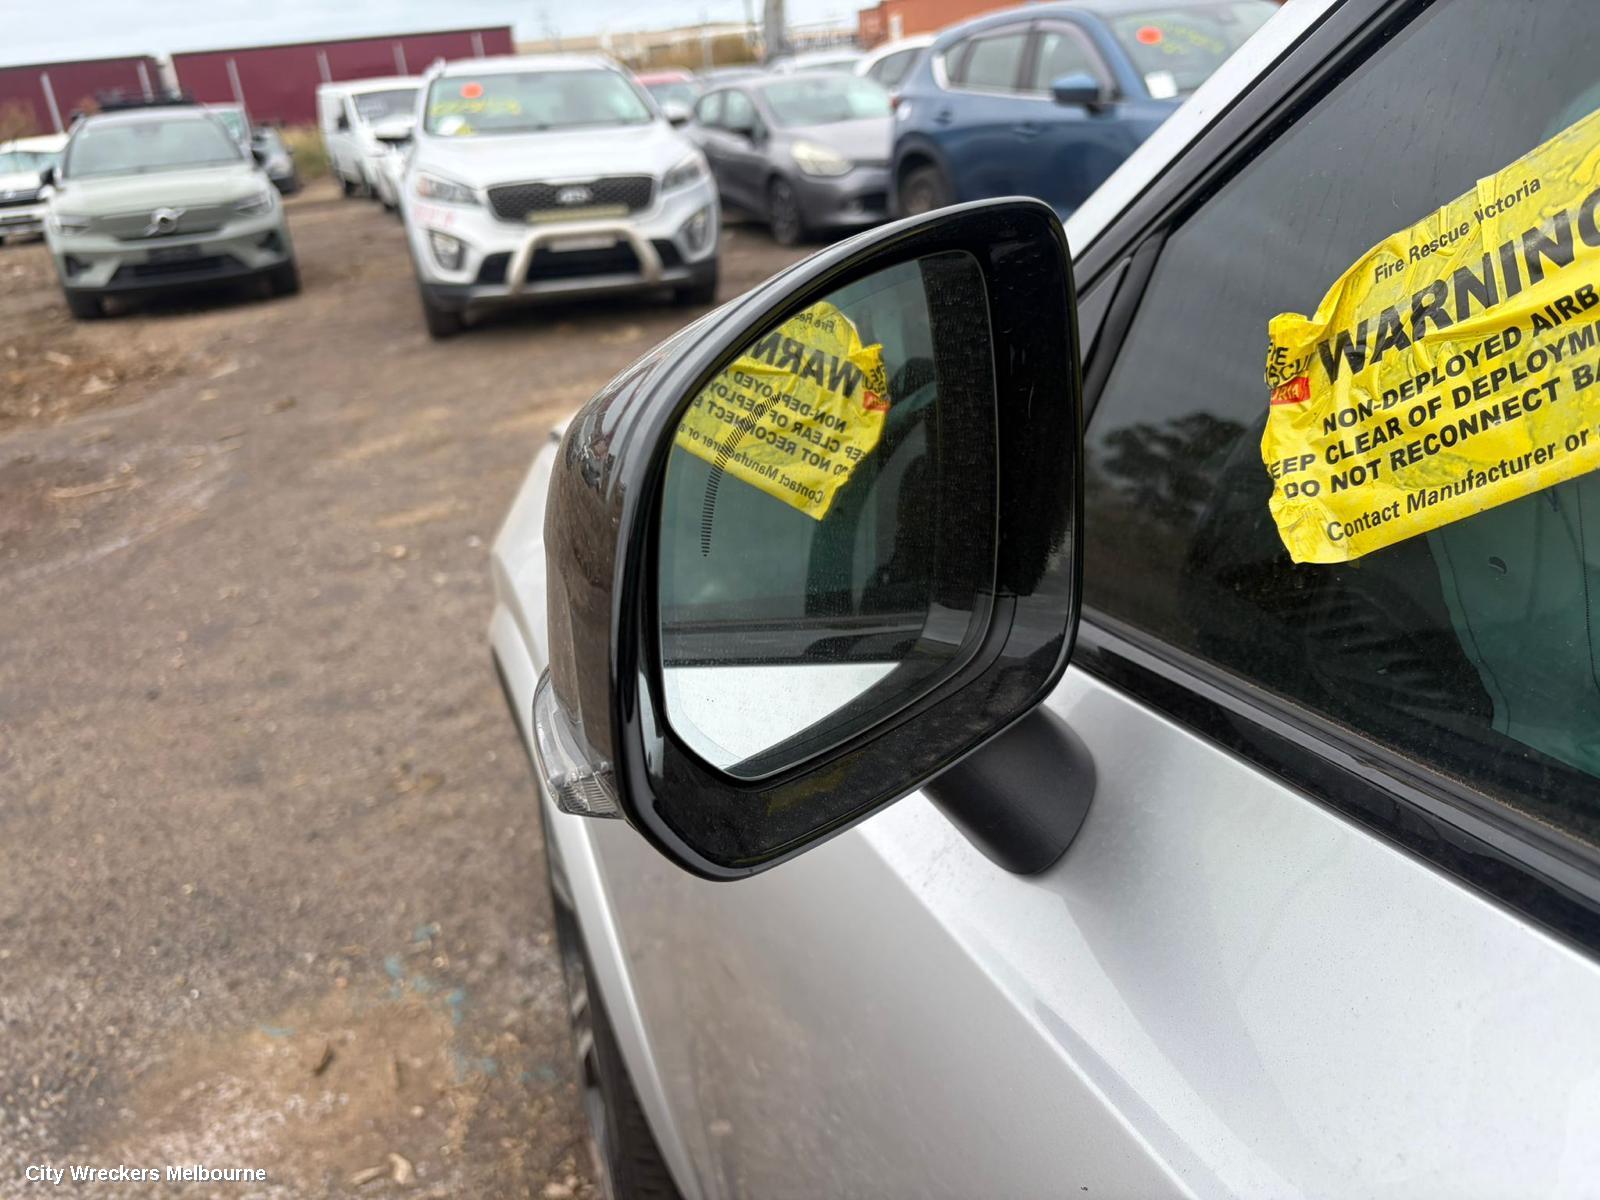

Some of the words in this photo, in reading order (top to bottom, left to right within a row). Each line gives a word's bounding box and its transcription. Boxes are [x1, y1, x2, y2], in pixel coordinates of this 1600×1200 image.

[1375, 258, 1405, 284] Fire
[1409, 222, 1470, 265] Rescue
[1268, 453, 1316, 480] EEP
[1325, 416, 1404, 465] CLEAR
[1408, 398, 1443, 432] OF
[1454, 320, 1600, 408] DEPLOYM
[1284, 479, 1320, 499] DO
[1331, 458, 1382, 493] NOT
[1390, 376, 1561, 469] RECONNECT
[1572, 358, 1600, 392] B
[1323, 326, 1522, 436] NON-DEPLOYED
[1530, 283, 1600, 338] AIRB
[1327, 501, 1401, 541] Contact
[1406, 442, 1557, 512] Manufacturer
[1564, 428, 1590, 453] or
